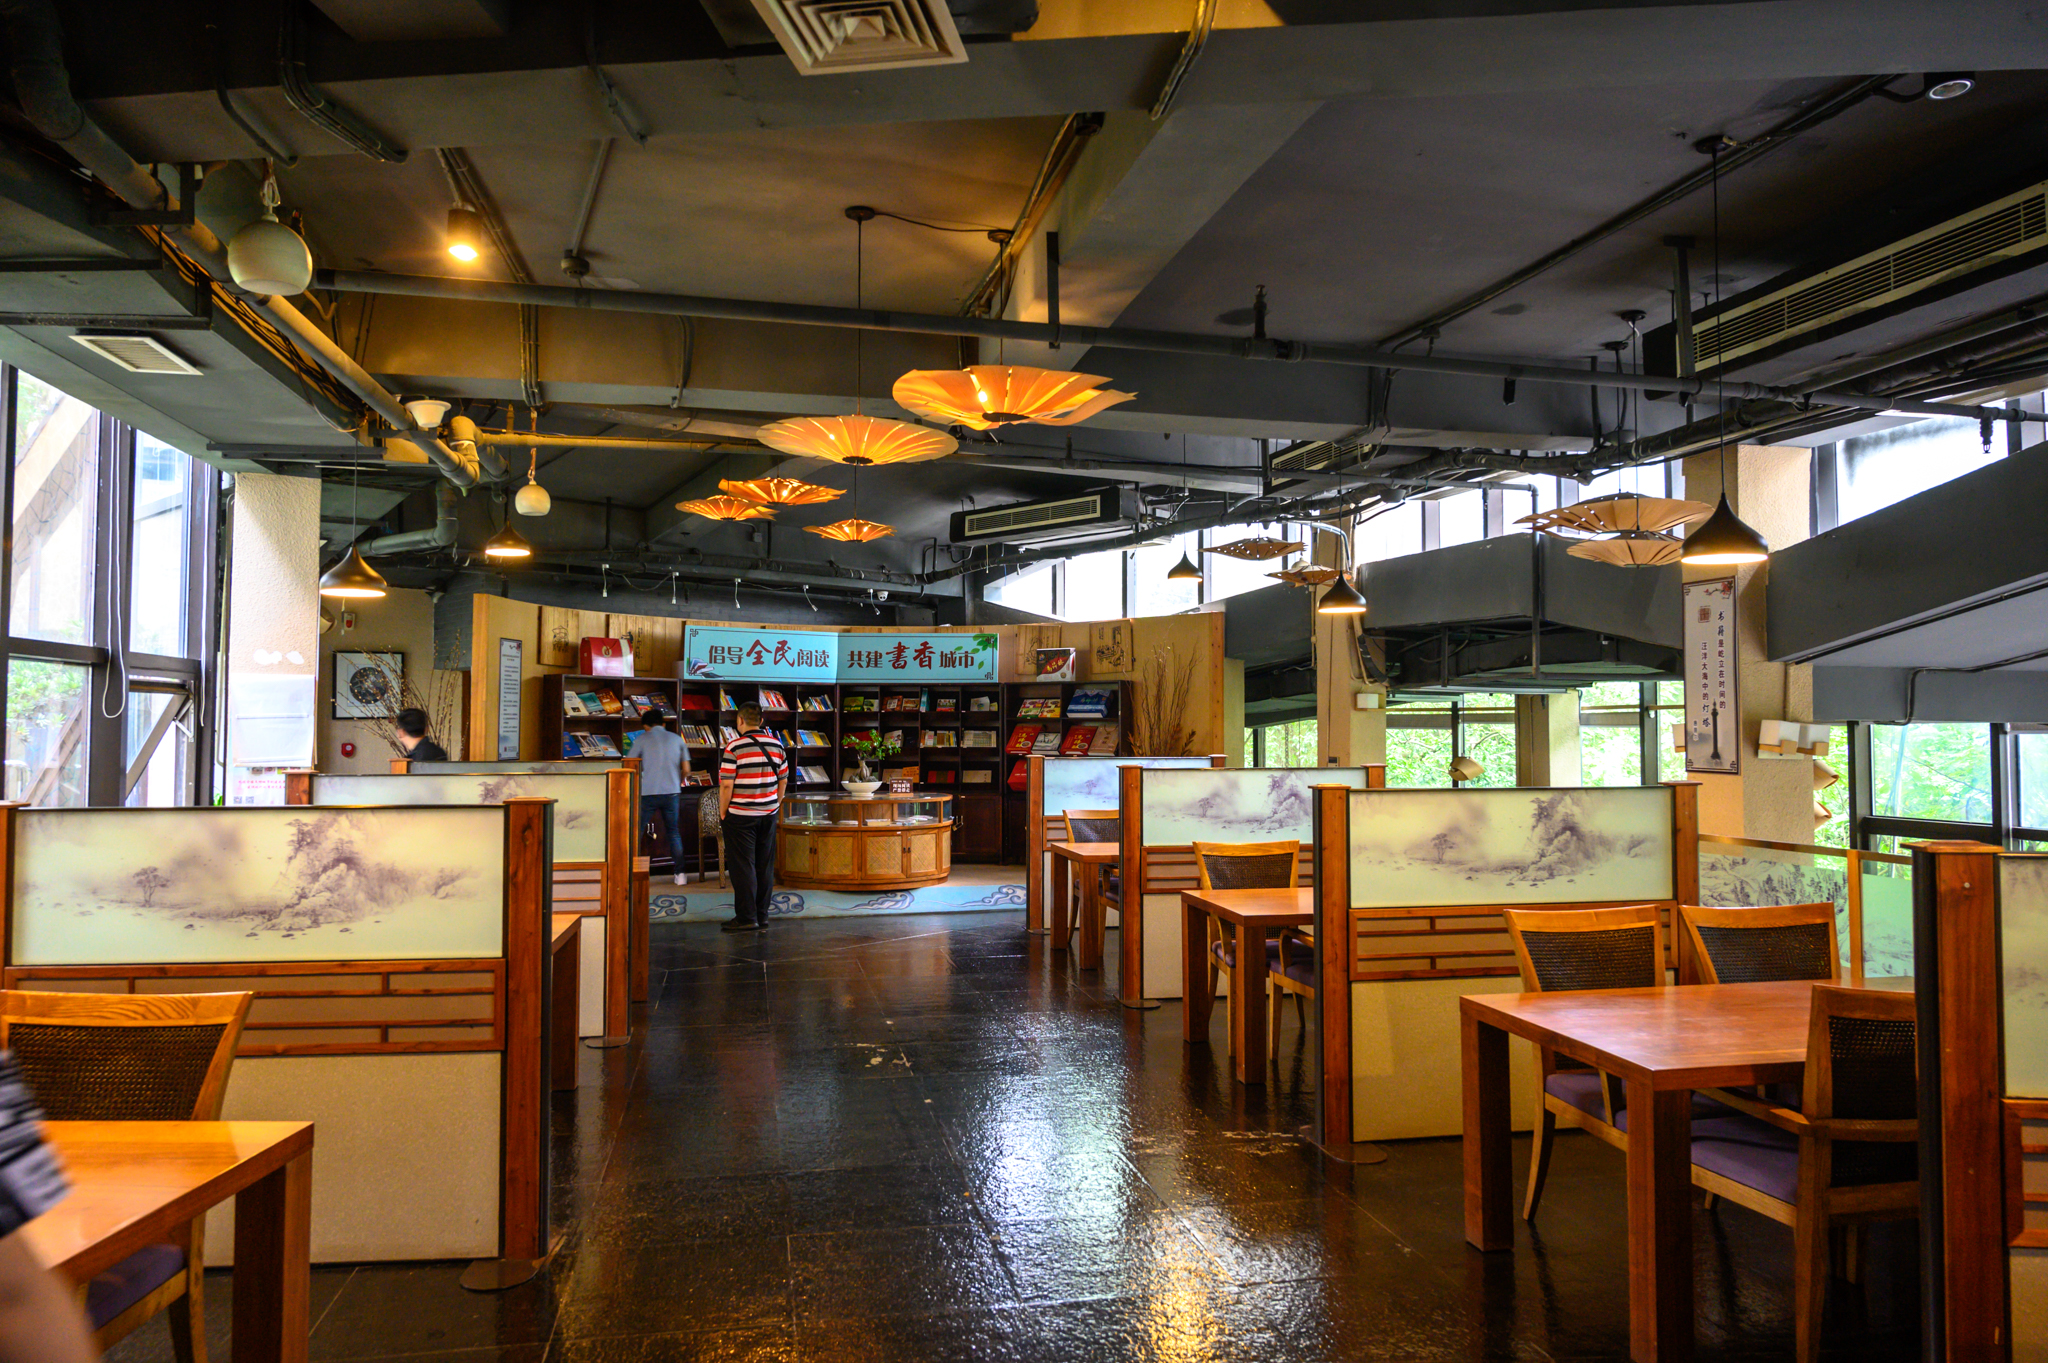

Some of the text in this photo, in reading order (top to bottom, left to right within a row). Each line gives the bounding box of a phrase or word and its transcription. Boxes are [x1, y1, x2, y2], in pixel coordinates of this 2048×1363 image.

[708, 638, 831, 669] 倡导全民阅读
[1701, 641, 1711, 728] 汪洋大海中的灯塔
